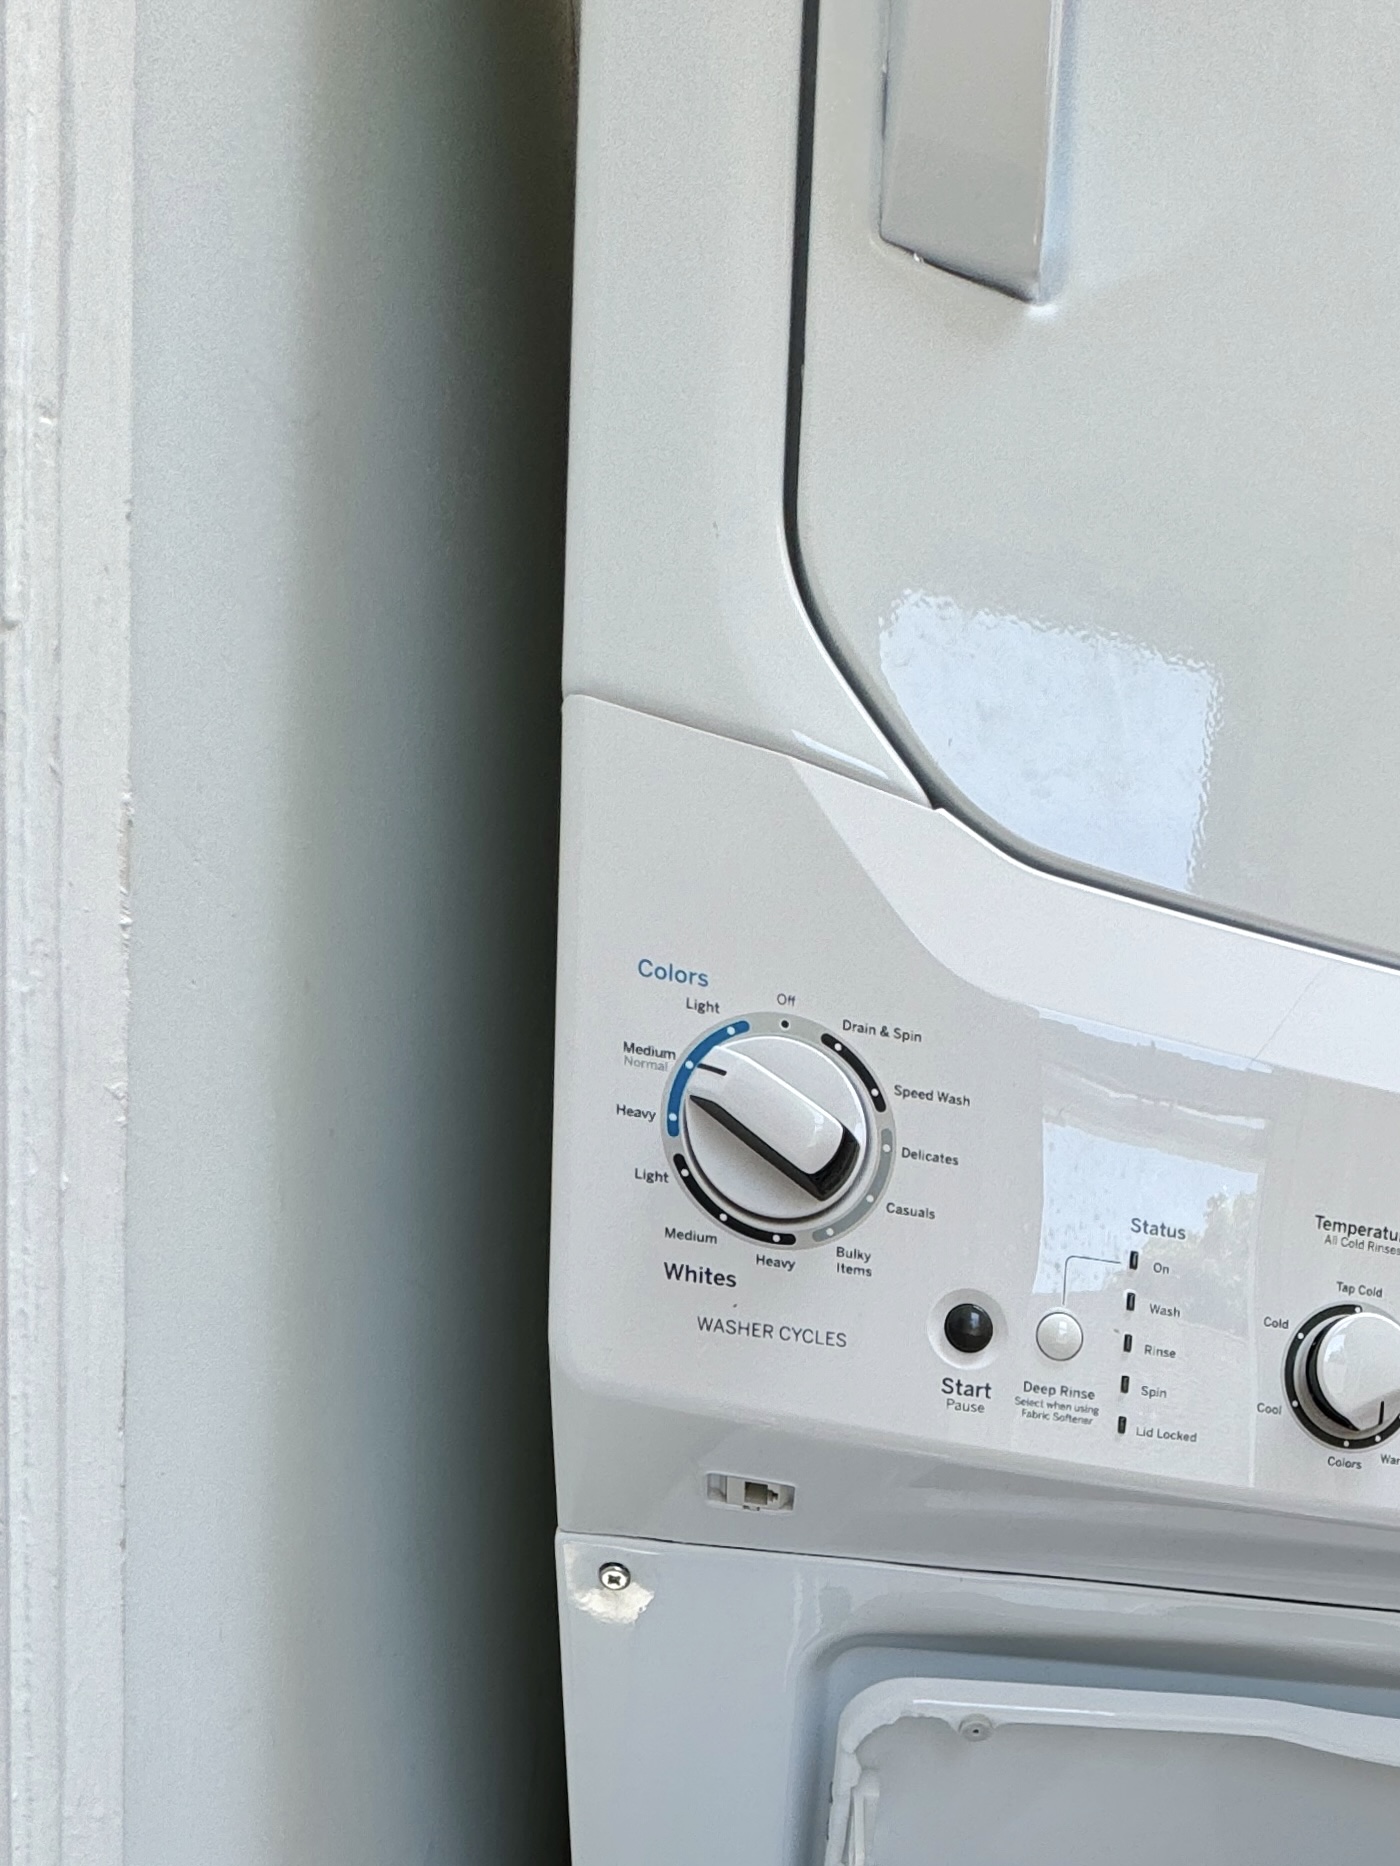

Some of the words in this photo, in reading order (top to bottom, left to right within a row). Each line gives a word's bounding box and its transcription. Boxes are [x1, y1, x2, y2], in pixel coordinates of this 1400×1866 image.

[637, 958, 710, 988] Colors
[685, 997, 720, 1014] Light
[777, 993, 796, 1007] Off
[842, 1019, 877, 1036] Drain
[880, 1024, 889, 1037] &
[891, 1027, 923, 1043] Spin
[623, 1041, 676, 1060] Medium
[623, 1056, 668, 1072] Normal
[894, 1084, 934, 1103] Speed
[938, 1091, 971, 1107] Wash
[616, 1104, 656, 1122] Heavy
[901, 1147, 960, 1166] Delicates
[634, 1168, 669, 1184] Light
[886, 1202, 936, 1220] Casuals
[665, 1227, 718, 1244] Medium
[1130, 1217, 1186, 1240] Status
[1324, 1235, 1338, 1246] All
[1340, 1236, 1365, 1250] Cold
[756, 1254, 796, 1271] Heavy
[836, 1246, 872, 1263] Bulky
[664, 1261, 737, 1288] Whites
[836, 1262, 873, 1278] Items
[1153, 1263, 1170, 1274] On
[1336, 1281, 1356, 1297] Tap
[1358, 1285, 1383, 1298] Cold
[1150, 1303, 1181, 1318] Wash
[1263, 1316, 1289, 1330] Cold
[697, 1316, 775, 1340] WASHER
[779, 1325, 848, 1348] CYCLES
[1144, 1345, 1176, 1359] Rinse
[941, 1378, 992, 1399] Start
[1023, 1381, 1056, 1397] Deep
[1059, 1385, 1095, 1400] Rinse
[1141, 1386, 1167, 1399] Spin
[946, 1399, 985, 1414] Pause
[1014, 1396, 1044, 1409] Select
[1046, 1401, 1071, 1411] when
[1073, 1404, 1099, 1416] using
[1257, 1403, 1282, 1415] Cool
[1021, 1409, 1050, 1421] Fabric
[1052, 1412, 1093, 1425] Softener
[1136, 1426, 1154, 1438] Lid
[1156, 1429, 1197, 1443] Locked
[1327, 1456, 1362, 1470] Colors
